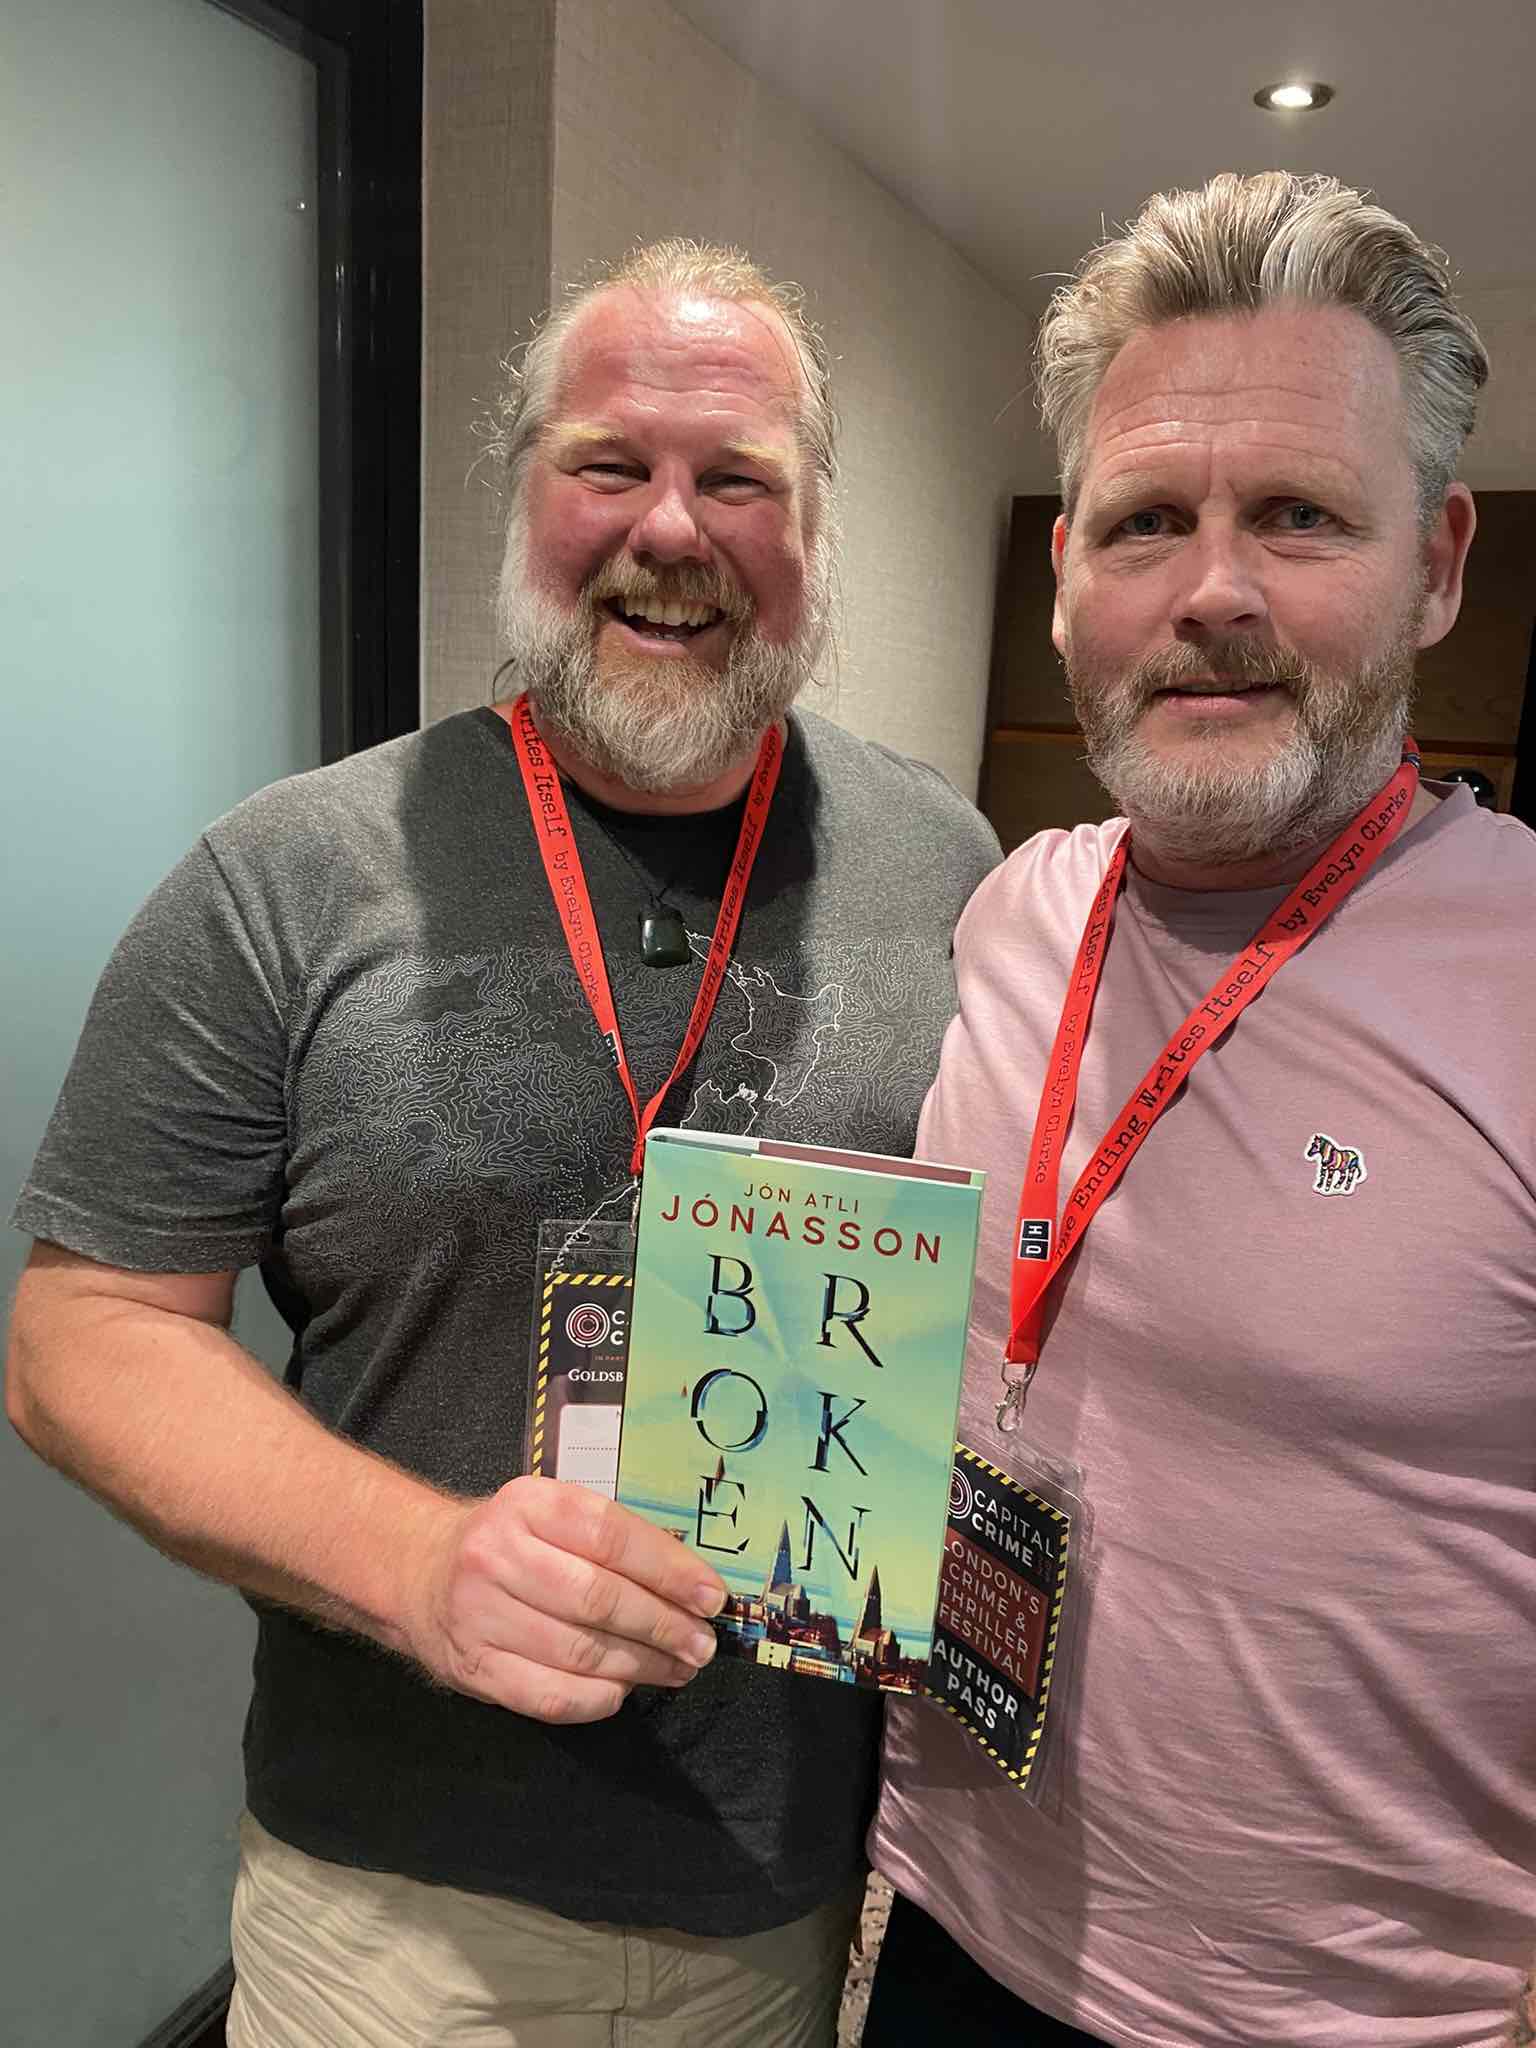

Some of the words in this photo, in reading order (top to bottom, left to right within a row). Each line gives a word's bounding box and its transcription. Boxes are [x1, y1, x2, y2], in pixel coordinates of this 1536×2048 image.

[534, 771, 567, 837] Itself
[554, 850, 569, 873] by
[560, 874, 586, 939] Evelyn
[1076, 920, 1105, 995] Itself
[1065, 1009, 1083, 1033] by
[1072, 1114, 1148, 1210] Ending
[1136, 1022, 1206, 1110] Writes
[1200, 940, 1276, 1022] Itself
[1279, 907, 1308, 932] by
[1302, 842, 1366, 908] Evelyn
[1360, 787, 1409, 841] Clarke
[1049, 1039, 1076, 1107] Evelyn
[1035, 1114, 1061, 1184] Clarke
[661, 1193, 941, 1264] JÓNASSON
[744, 1183, 791, 1203] JÓN
[804, 1193, 859, 1214] ATLI
[971, 1512, 1034, 1568] CRIME
[974, 1489, 1055, 1559] CAPITAL
[941, 1578, 1030, 1661] THRILLER
[949, 1562, 1010, 1618] CRIME
[1016, 1610, 1027, 1632] &
[939, 1602, 1025, 1684] FESTIVAL
[933, 1638, 1019, 1721] AUTHOR
[947, 1672, 998, 1730] PASS
